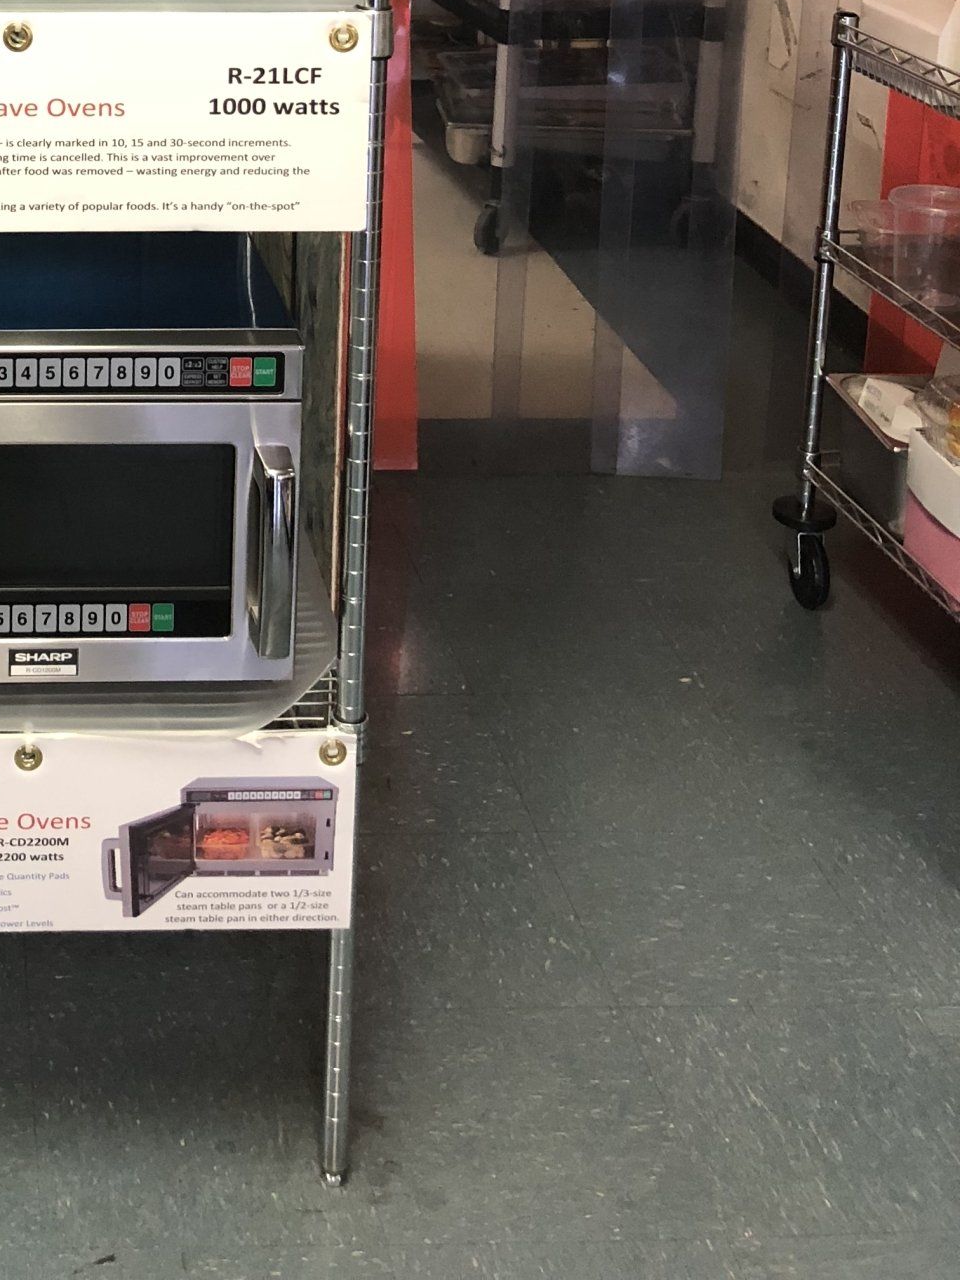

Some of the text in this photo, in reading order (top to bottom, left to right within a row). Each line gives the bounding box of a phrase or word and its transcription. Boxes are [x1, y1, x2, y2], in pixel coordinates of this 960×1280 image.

[228, 67, 322, 84] R-21LCF
[47, 98, 125, 117] Ovens
[209, 98, 339, 115] 1000 watts
[6, 139, 14, 147] is
[17, 139, 52, 149] clearly
[55, 138, 95, 147] marked
[99, 139, 108, 147] in
[112, 139, 127, 148] 10,
[131, 138, 144, 147] 15
[147, 139, 167, 147] and
[170, 138, 225, 147] 30-second
[228, 137, 291, 147] increments.
[29, 202, 65, 212] variety
[68, 202, 80, 210] of
[82, 202, 123, 212] popular
[126, 202, 159, 210] foods.
[163, 202, 178, 210] It's
[191, 202, 224, 212] handy
[227, 202, 300, 212] "on-the-spot"
[21, 366, 31, 380] 4
[46, 366, 55, 380] 5
[69, 366, 79, 380] 6
[94, 366, 103, 379] 7
[117, 366, 127, 380] 8
[141, 365, 150, 379] 9
[165, 365, 174, 379] 0
[17, 612, 27, 626] 6
[42, 612, 51, 625] 7
[64, 612, 74, 625] 8
[88, 611, 97, 625] 9
[111, 611, 121, 625] 0
[14, 652, 72, 662] SHARP
[17, 813, 91, 830] Ovens
[30, 853, 64, 861] watts
[7, 872, 47, 881] Quantity
[48, 872, 70, 880] Pads
[174, 889, 332, 899] Can accommodate two 1/3-size
[210, 902, 236, 911] table
[238, 903, 262, 911] pans
[290, 901, 329, 911] 1/2-size
[26, 920, 54, 928] Levels
[198, 914, 224, 923] table
[227, 916, 245, 924] pan
[248, 914, 257, 922] in
[260, 914, 289, 922] either
[292, 914, 339, 922] direction.
